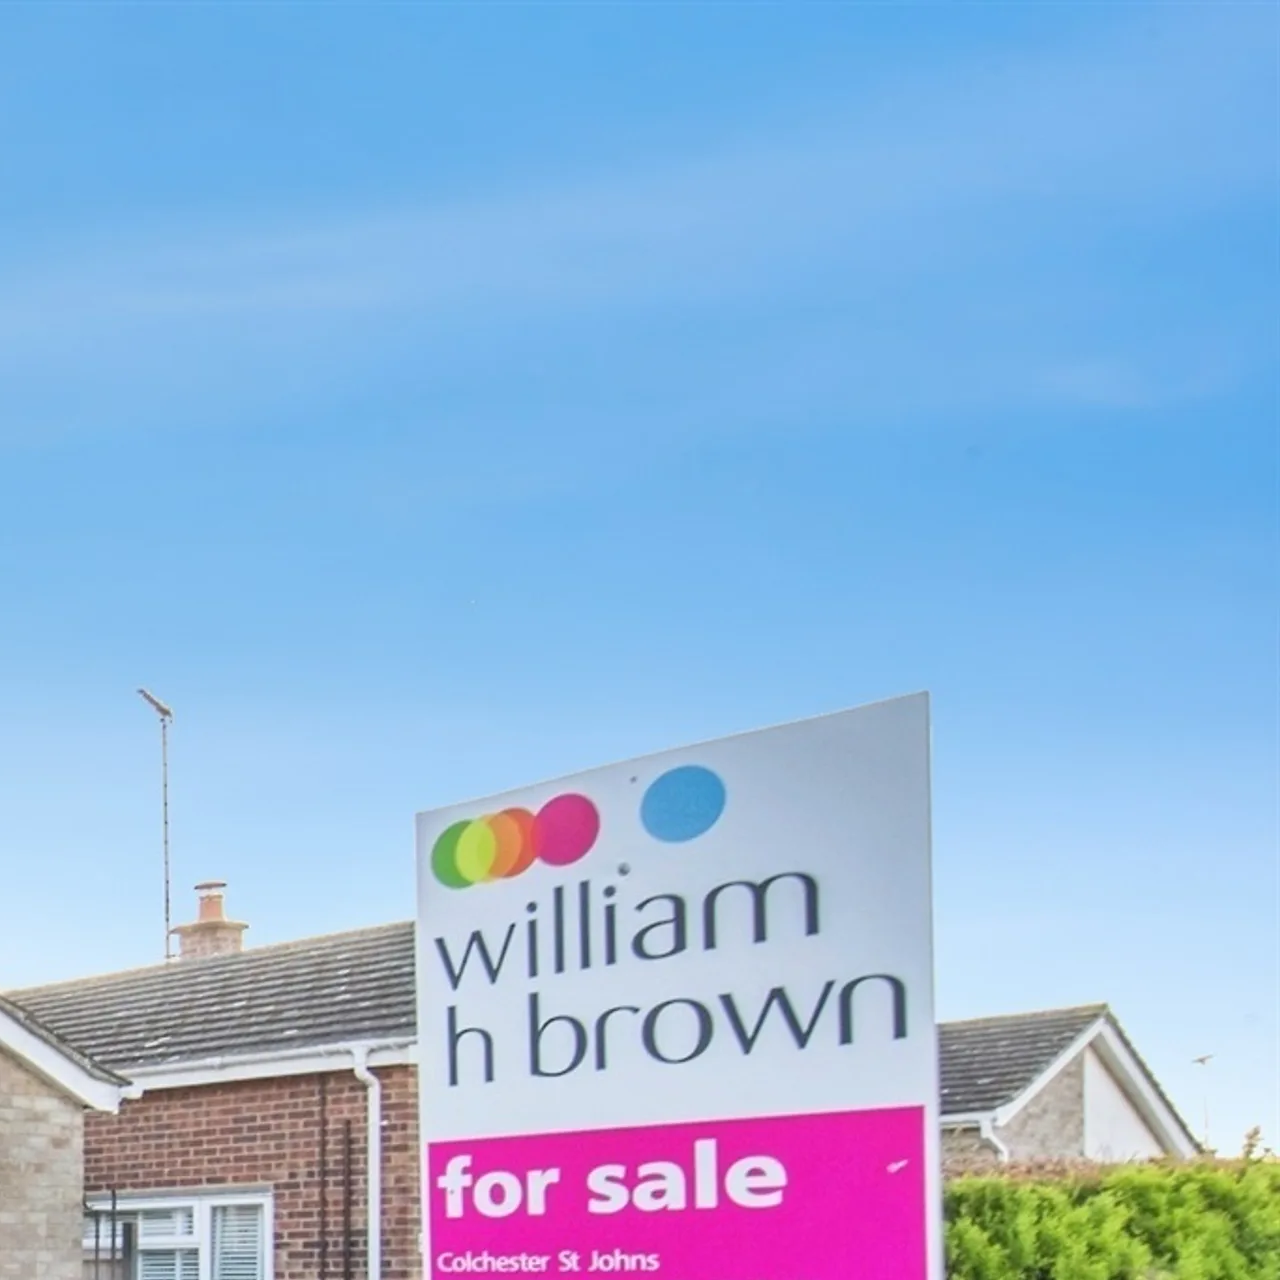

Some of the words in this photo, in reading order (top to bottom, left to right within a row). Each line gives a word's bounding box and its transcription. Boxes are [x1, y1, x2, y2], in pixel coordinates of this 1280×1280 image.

[433, 870, 821, 991] william
[446, 1004, 495, 1087] h
[527, 973, 909, 1078] brown
[436, 1154, 560, 1219] for
[585, 1137, 788, 1215] sale
[437, 1250, 550, 1273] Colchester
[558, 1249, 581, 1272] St
[587, 1248, 660, 1272] Johns
